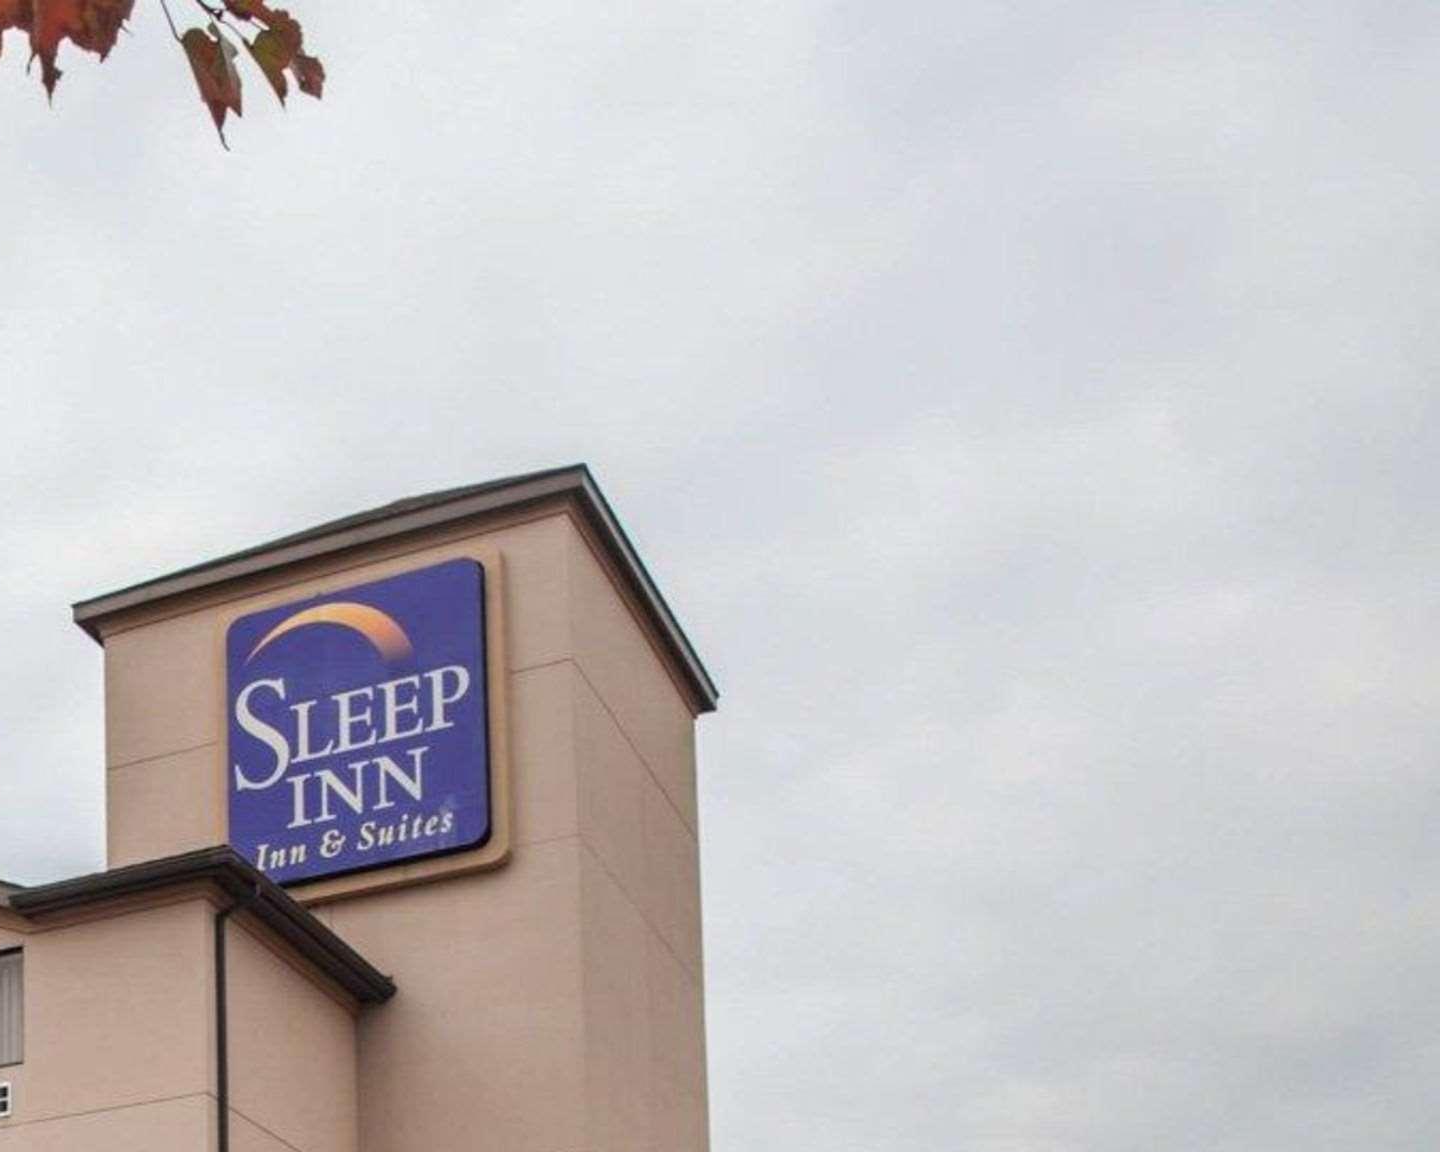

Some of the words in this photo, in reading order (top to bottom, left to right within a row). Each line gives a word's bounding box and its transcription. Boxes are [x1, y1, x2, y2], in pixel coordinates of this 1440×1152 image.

[234, 665, 470, 791] SLEEP
[287, 746, 429, 828] INN
[256, 843, 307, 871] Inn
[319, 829, 346, 858] &
[357, 812, 454, 850] Suites
